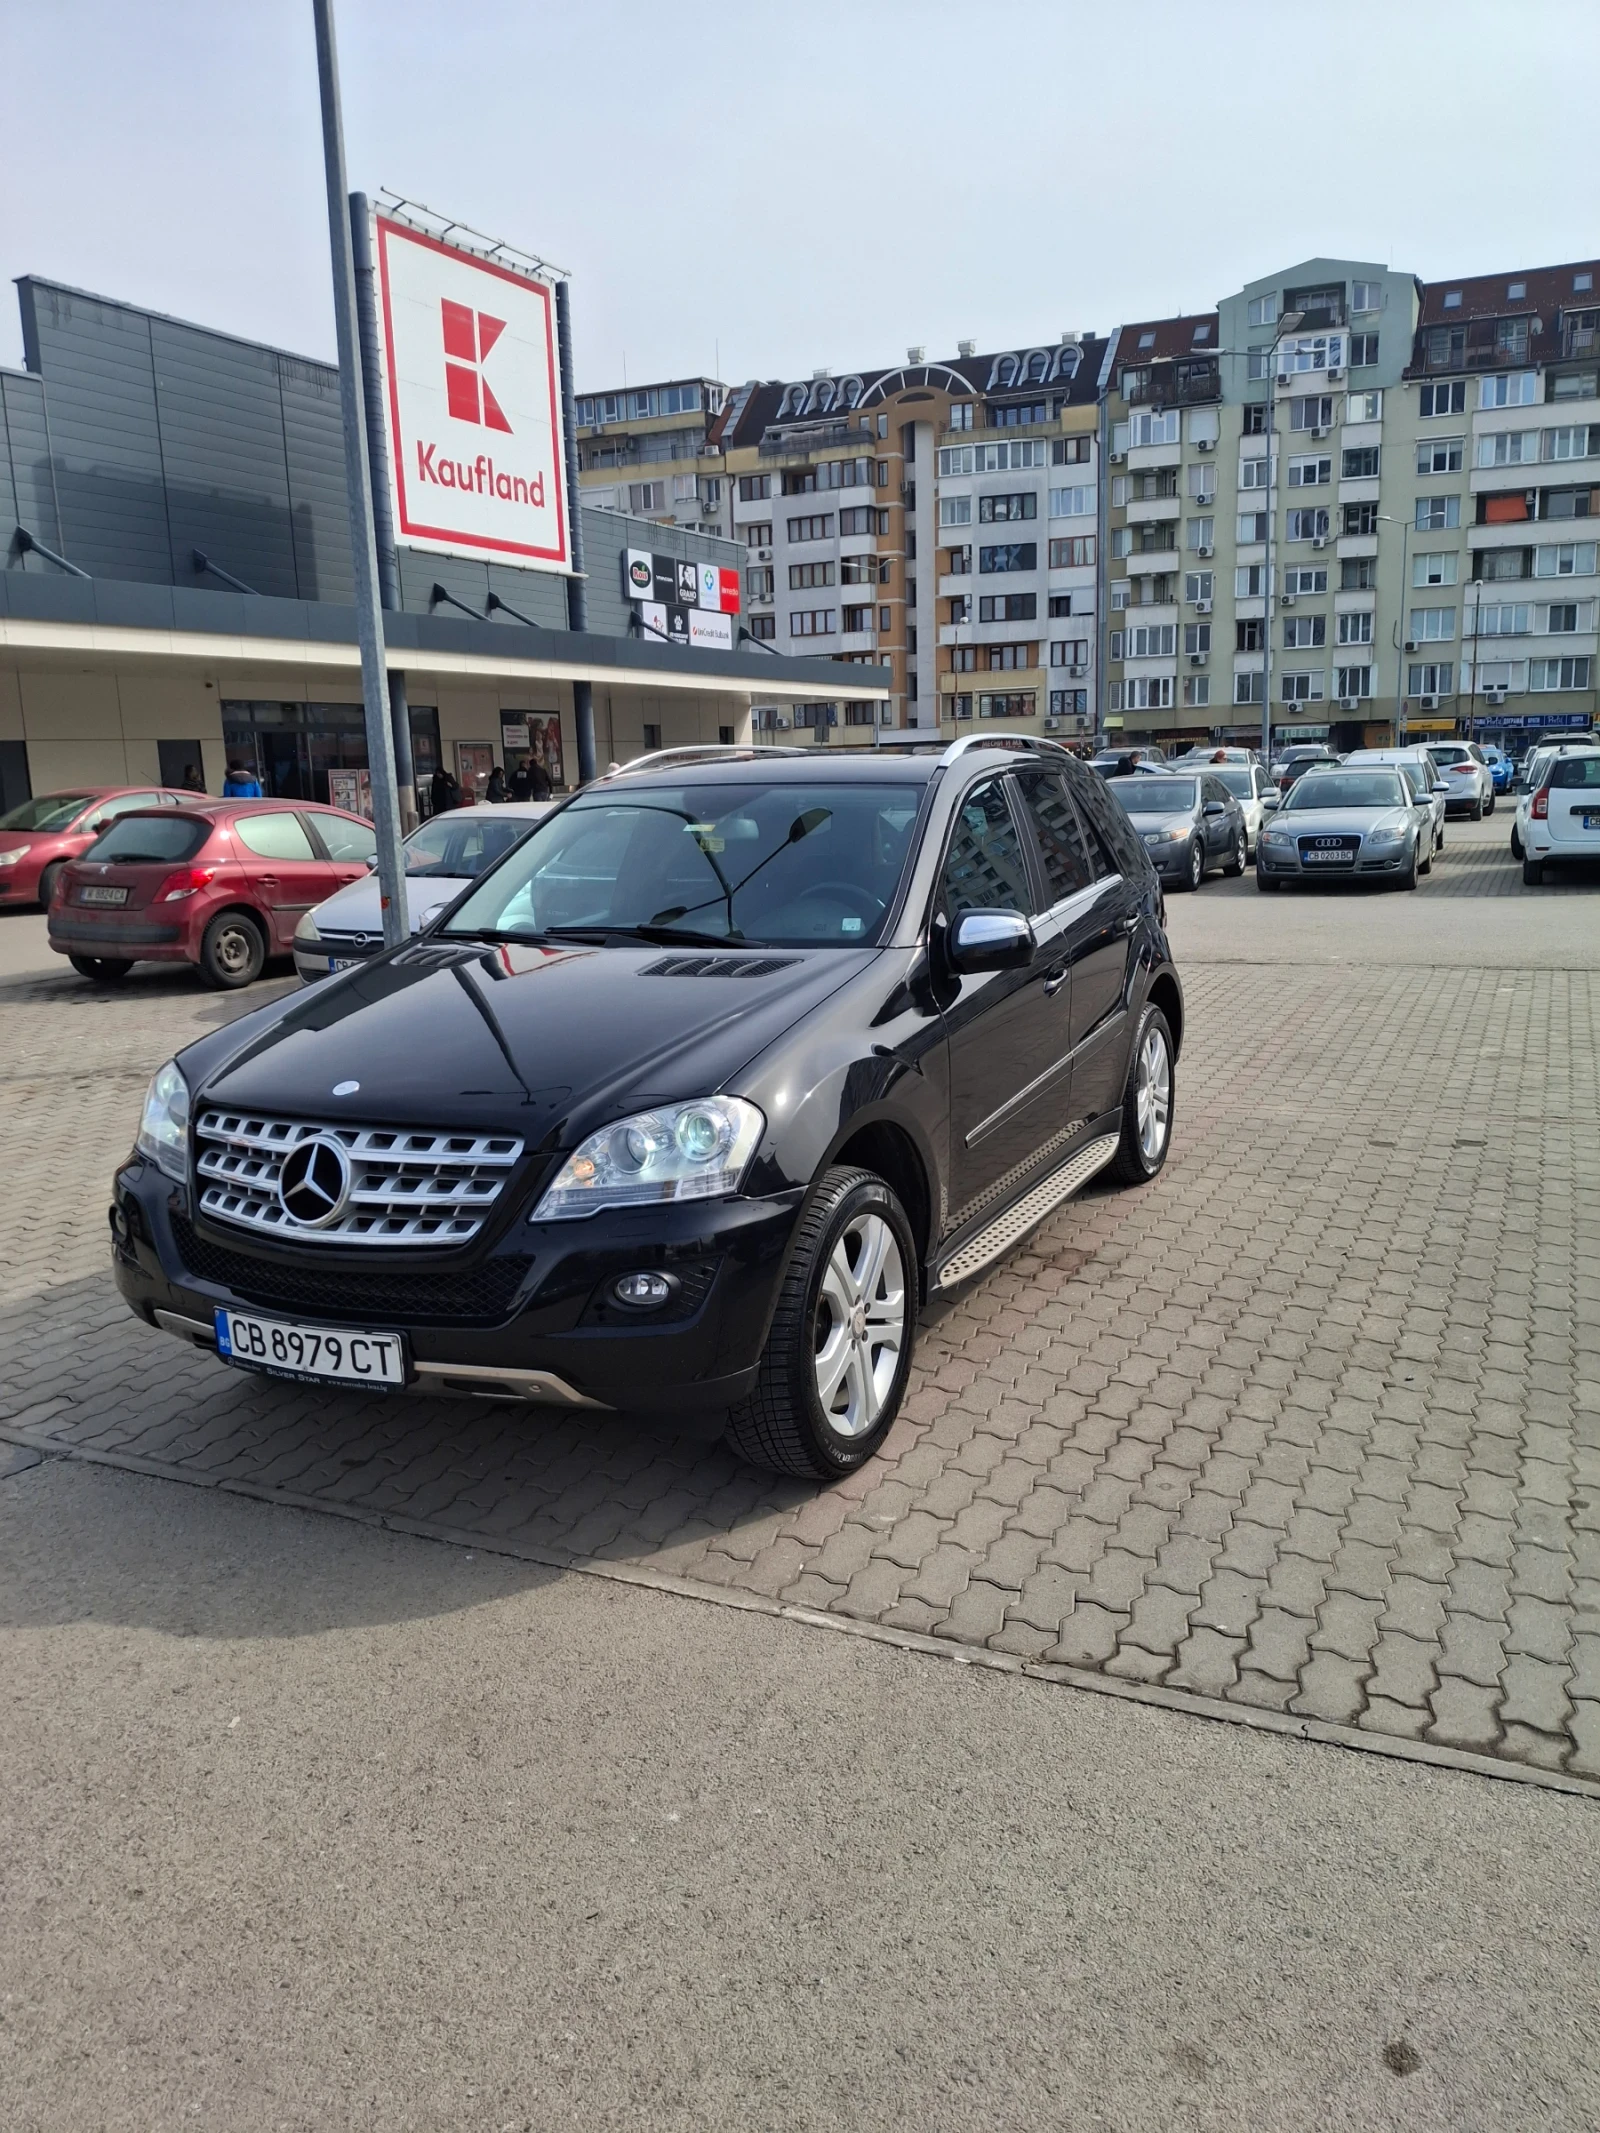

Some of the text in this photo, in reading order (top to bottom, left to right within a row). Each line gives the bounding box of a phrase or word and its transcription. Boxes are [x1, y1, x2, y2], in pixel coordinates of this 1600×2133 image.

[417, 439, 545, 508] Kaufland
[697, 627, 715, 637] UniCredit
[715, 629, 730, 639] Bulbank
[1308, 852, 1319, 860] CB
[1320, 852, 1340, 860] 0203
[1340, 851, 1352, 860] BC
[220, 1336, 231, 1348] BG
[232, 1319, 392, 1376] CB 8979 CT
